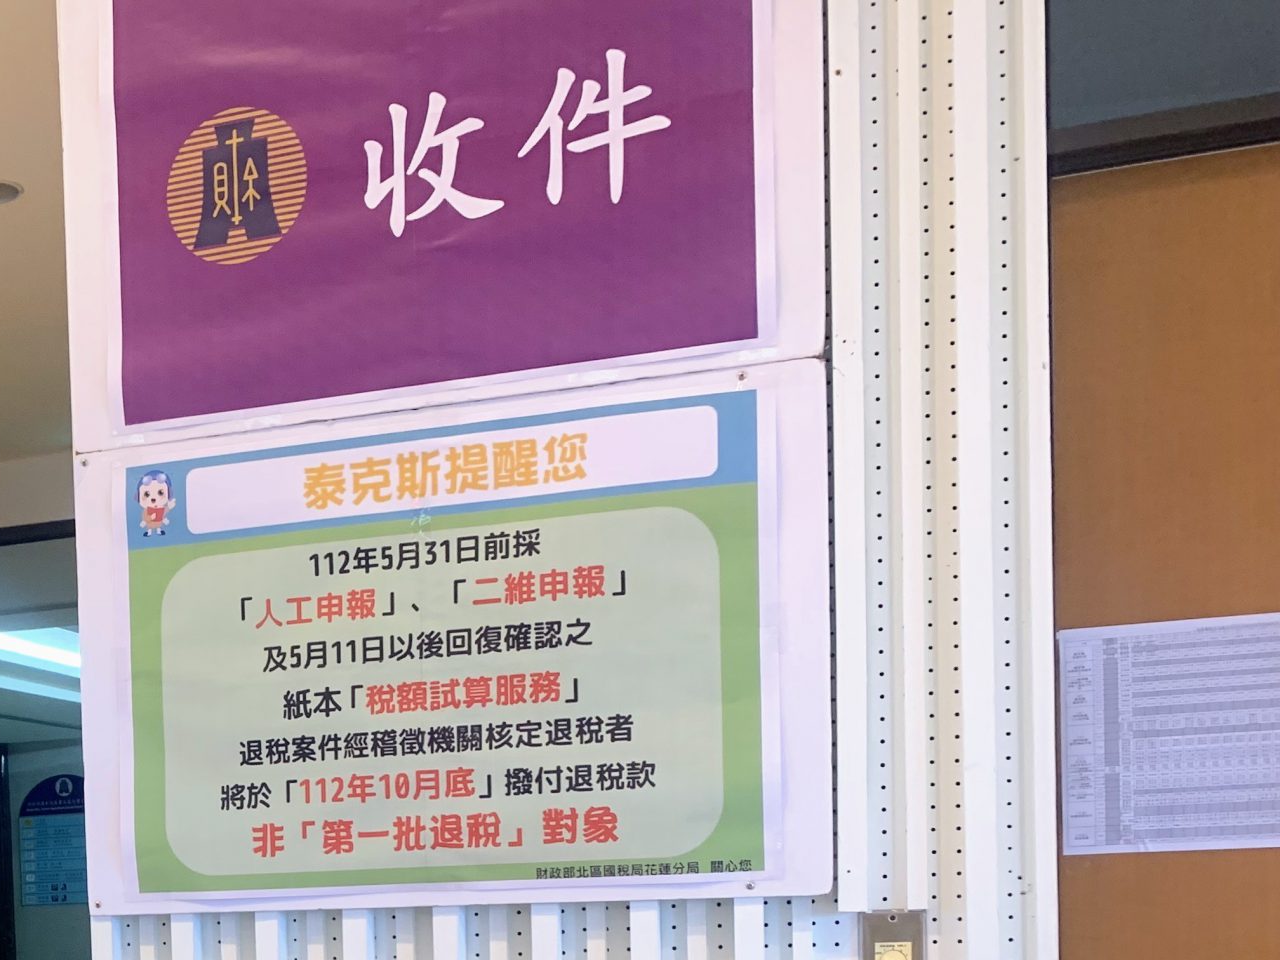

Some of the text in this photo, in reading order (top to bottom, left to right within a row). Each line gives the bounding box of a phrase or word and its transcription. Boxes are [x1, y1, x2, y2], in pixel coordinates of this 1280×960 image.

[363, 48, 672, 238] 收件
[303, 432, 589, 510] 泰克斯提醒您
[308, 528, 541, 577] 112年5月31日前採
[262, 618, 593, 673] 及5月11日以後回復確認之
[239, 713, 635, 767] 退稅案件經稽徵機關核定退稅者
[535, 859, 753, 880] 財政部北區國稅局花蓮分局 關心您
